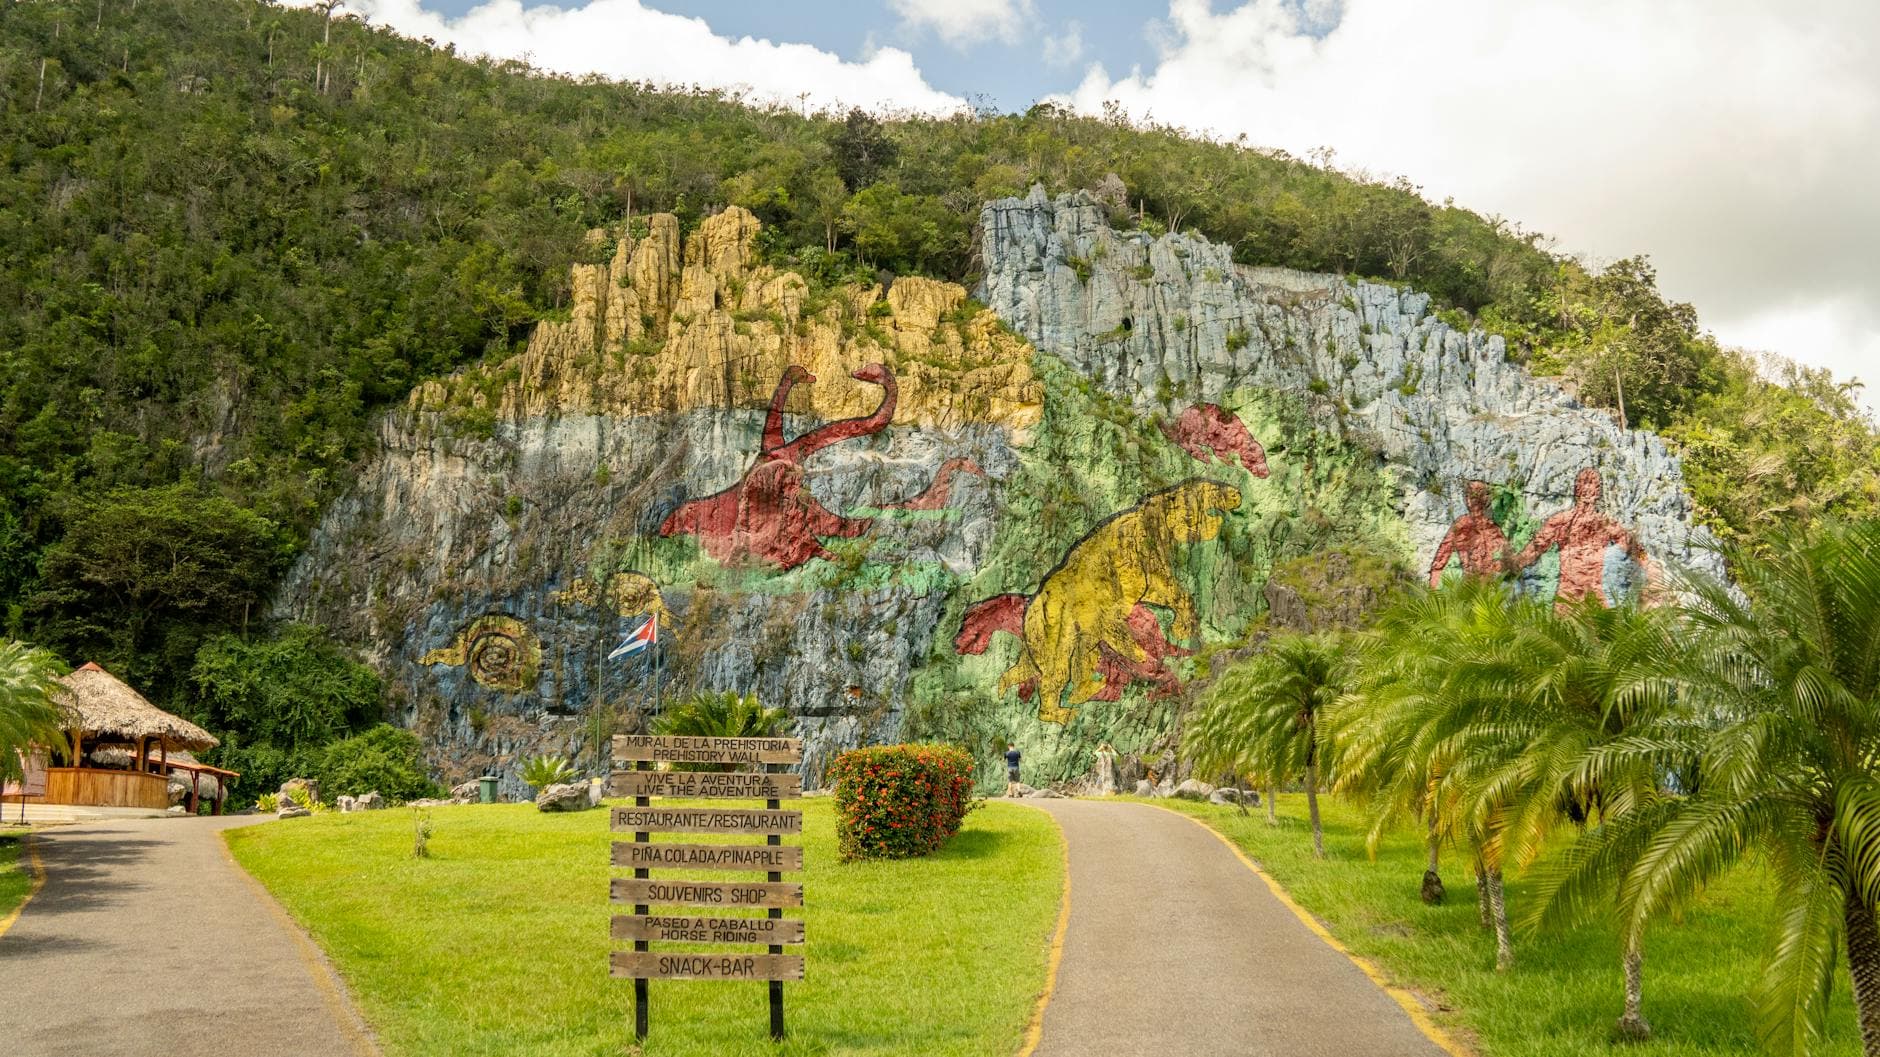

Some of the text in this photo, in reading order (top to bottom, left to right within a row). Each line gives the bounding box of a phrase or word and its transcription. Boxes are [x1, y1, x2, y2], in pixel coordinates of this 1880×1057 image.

[626, 736, 791, 751] MURAL DE LA PREHISTORIA
[653, 750, 762, 763] PREHISTORY WALL
[645, 774, 771, 786] VIVE LA AVENTURA
[636, 784, 779, 797] LIVE THE ADVENTURE
[618, 811, 796, 829] RESTAURANTE/RESTAURANT
[632, 847, 784, 865] PIÑA COLADA/PINAPPLE
[648, 885, 767, 904] SOUVENIRS SHOP
[644, 917, 774, 931] PASEO A CABALLO
[661, 930, 757, 943] HORSE RIDING
[659, 956, 755, 977] SNACK-BAR
